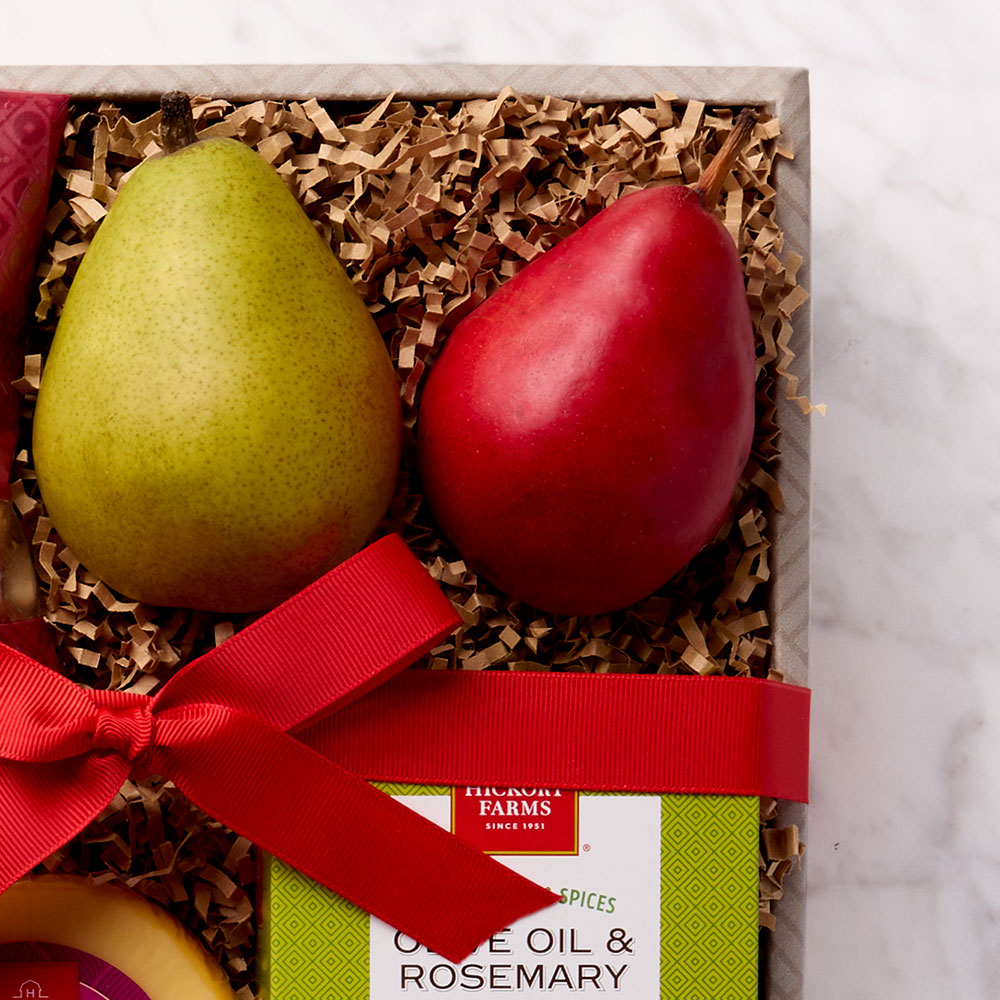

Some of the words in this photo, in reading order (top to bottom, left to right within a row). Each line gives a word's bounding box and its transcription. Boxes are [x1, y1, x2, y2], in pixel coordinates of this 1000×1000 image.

[479, 800, 552, 816] FARMS
[485, 822, 518, 830] SINCE
[523, 822, 545, 830] 1951
[559, 888, 617, 914] SPICES
[526, 928, 592, 955] OIL
[606, 928, 635, 955] &
[400, 964, 628, 991] ROSEMARY
